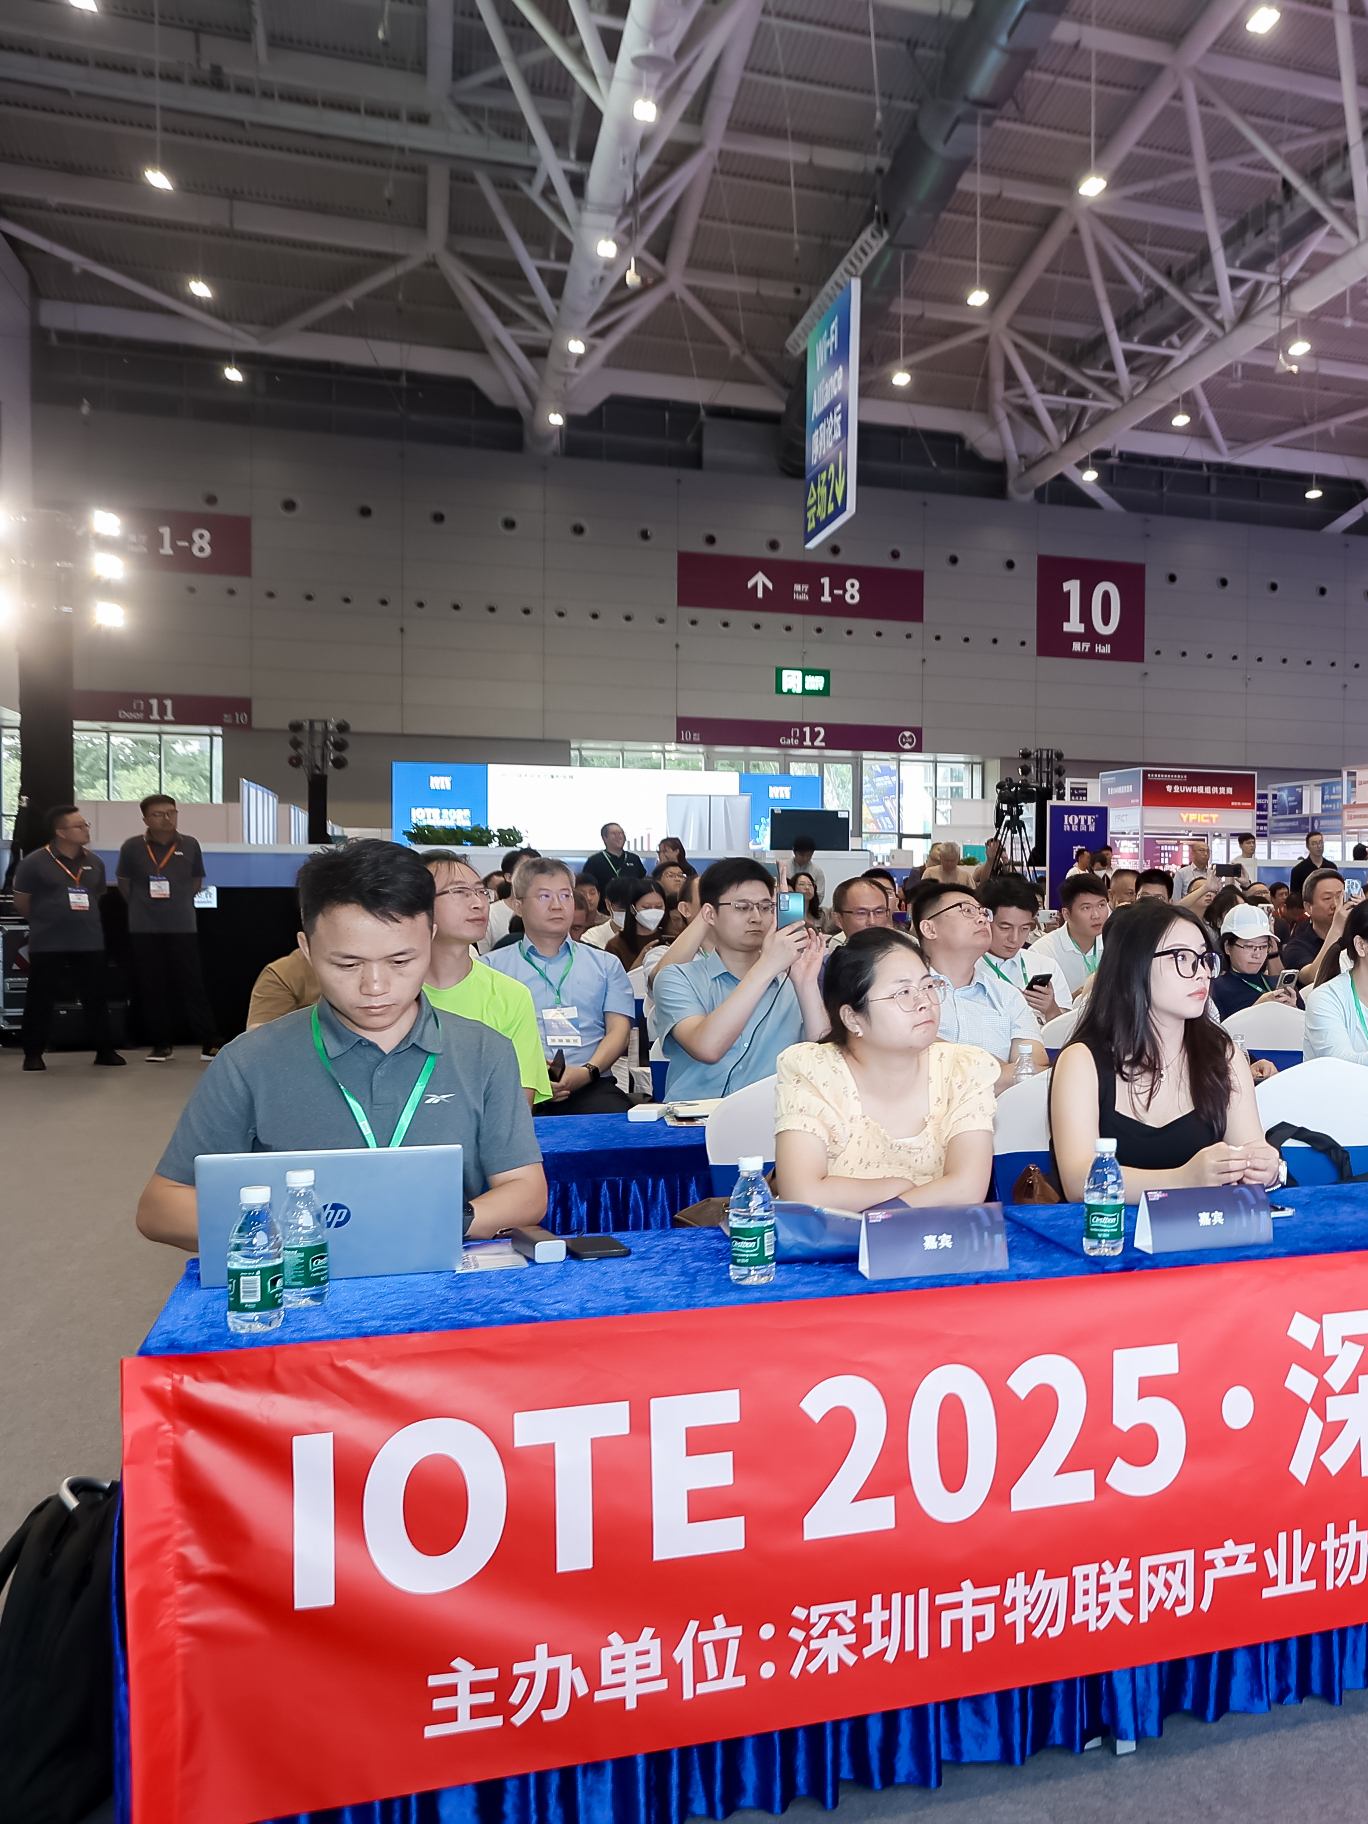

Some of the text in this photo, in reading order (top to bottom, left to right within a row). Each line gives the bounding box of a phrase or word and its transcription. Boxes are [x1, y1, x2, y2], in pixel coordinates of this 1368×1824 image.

[815, 315, 838, 372] Wi-Fi
[811, 365, 843, 421] Alliance
[158, 525, 212, 559] 1-8
[820, 576, 861, 605] 1-8
[1062, 579, 1121, 636] 10
[1072, 641, 1111, 654] 展厅 Hall
[149, 698, 175, 721] 11
[680, 730, 691, 742] 10
[779, 735, 799, 746] Gate
[802, 726, 826, 747] 12
[1063, 814, 1096, 825] IOTE
[1198, 1210, 1225, 1227] 嘉宾
[923, 1232, 954, 1251] 嘉宾
[291, 1388, 746, 1611] IOTE
